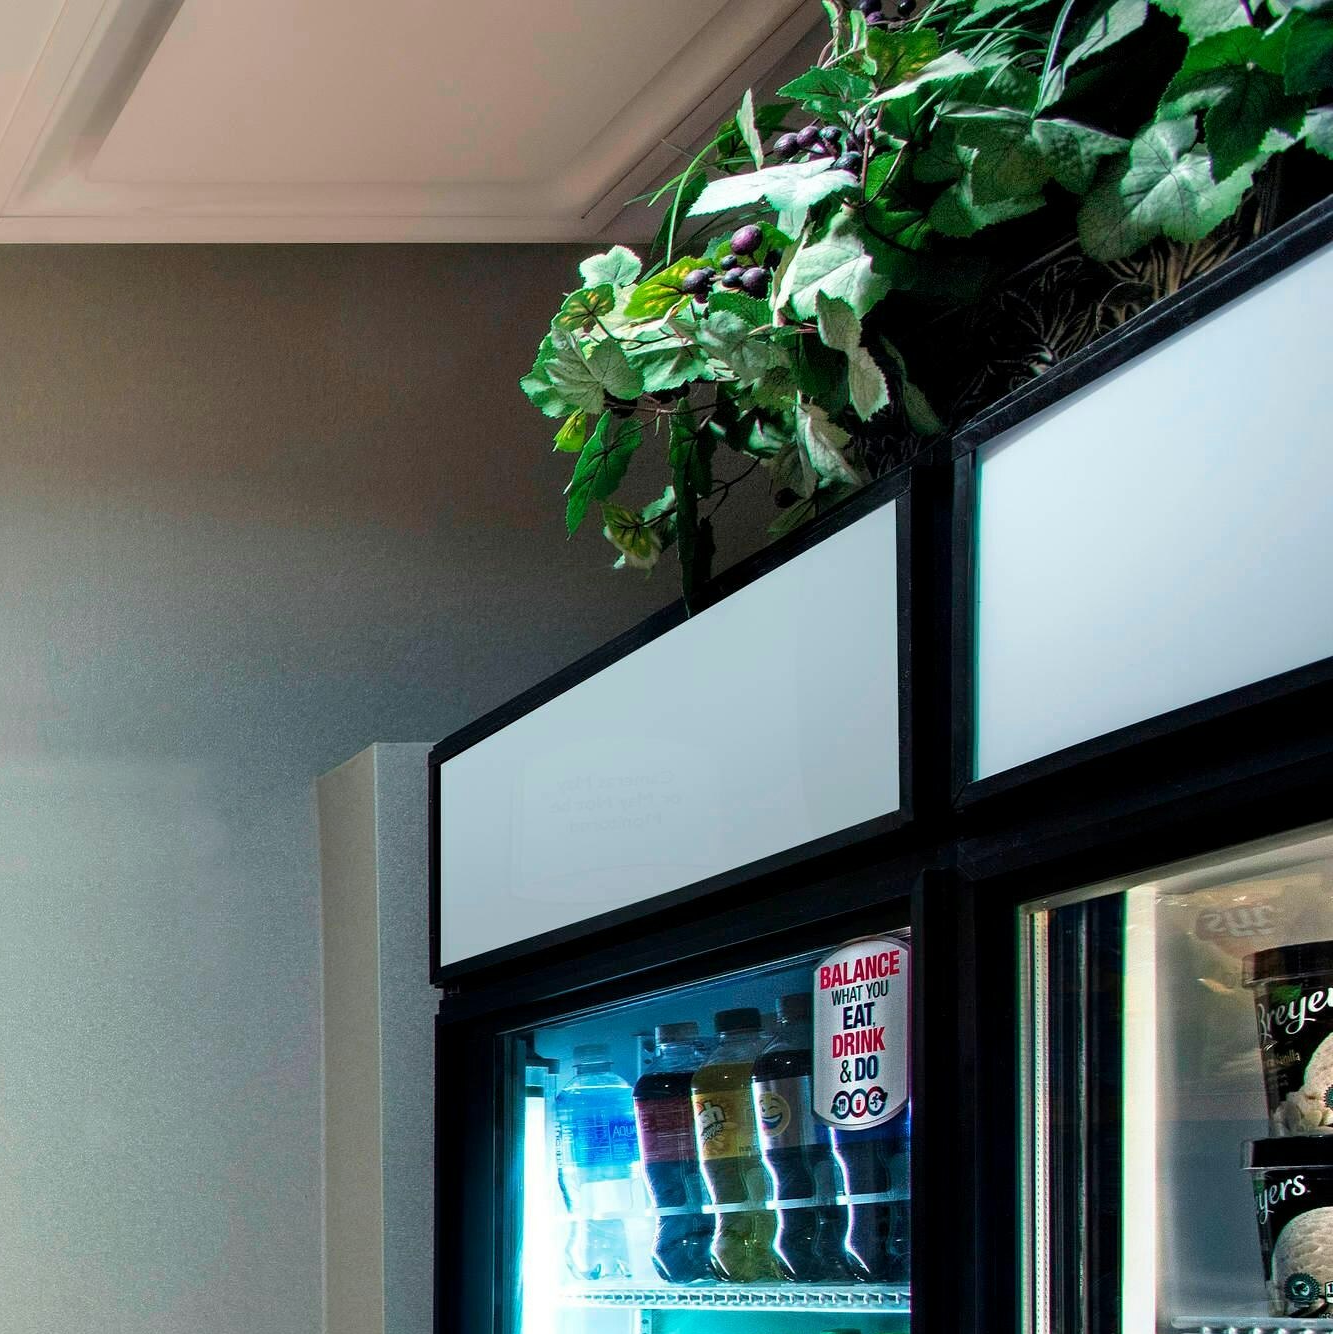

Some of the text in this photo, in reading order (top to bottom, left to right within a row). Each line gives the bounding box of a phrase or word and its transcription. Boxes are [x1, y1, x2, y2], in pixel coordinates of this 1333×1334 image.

[820, 950, 900, 991] BALANCE
[831, 979, 889, 1006] WHAT YOU
[843, 1002, 877, 1029] EAT,
[832, 1026, 886, 1060] DRINK
[839, 1054, 879, 1084] & DO
